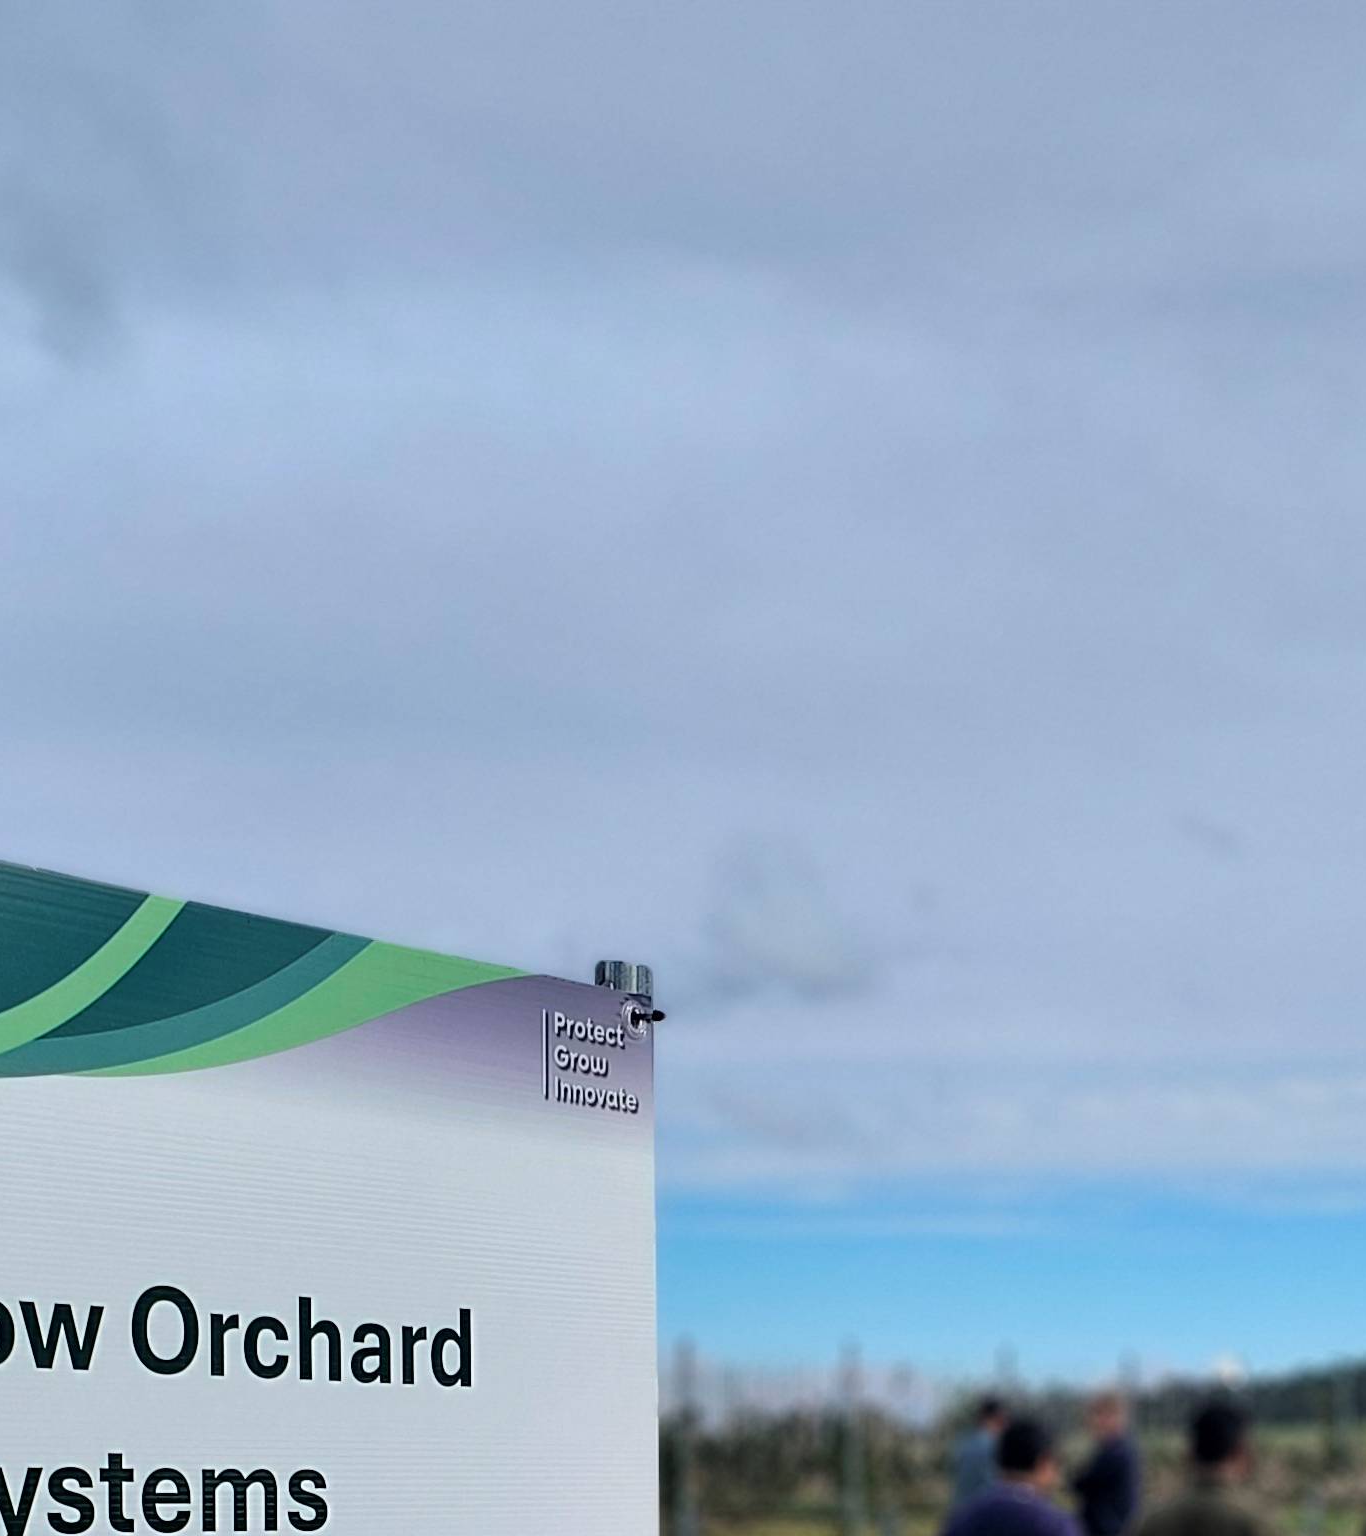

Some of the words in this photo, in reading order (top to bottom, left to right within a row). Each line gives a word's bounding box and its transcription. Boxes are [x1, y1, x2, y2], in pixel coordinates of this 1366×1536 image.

[554, 1011, 624, 1047] Protect
[554, 1045, 608, 1075] Grow
[554, 1075, 638, 1112] Innovate
[130, 1284, 474, 1388] Orchard
